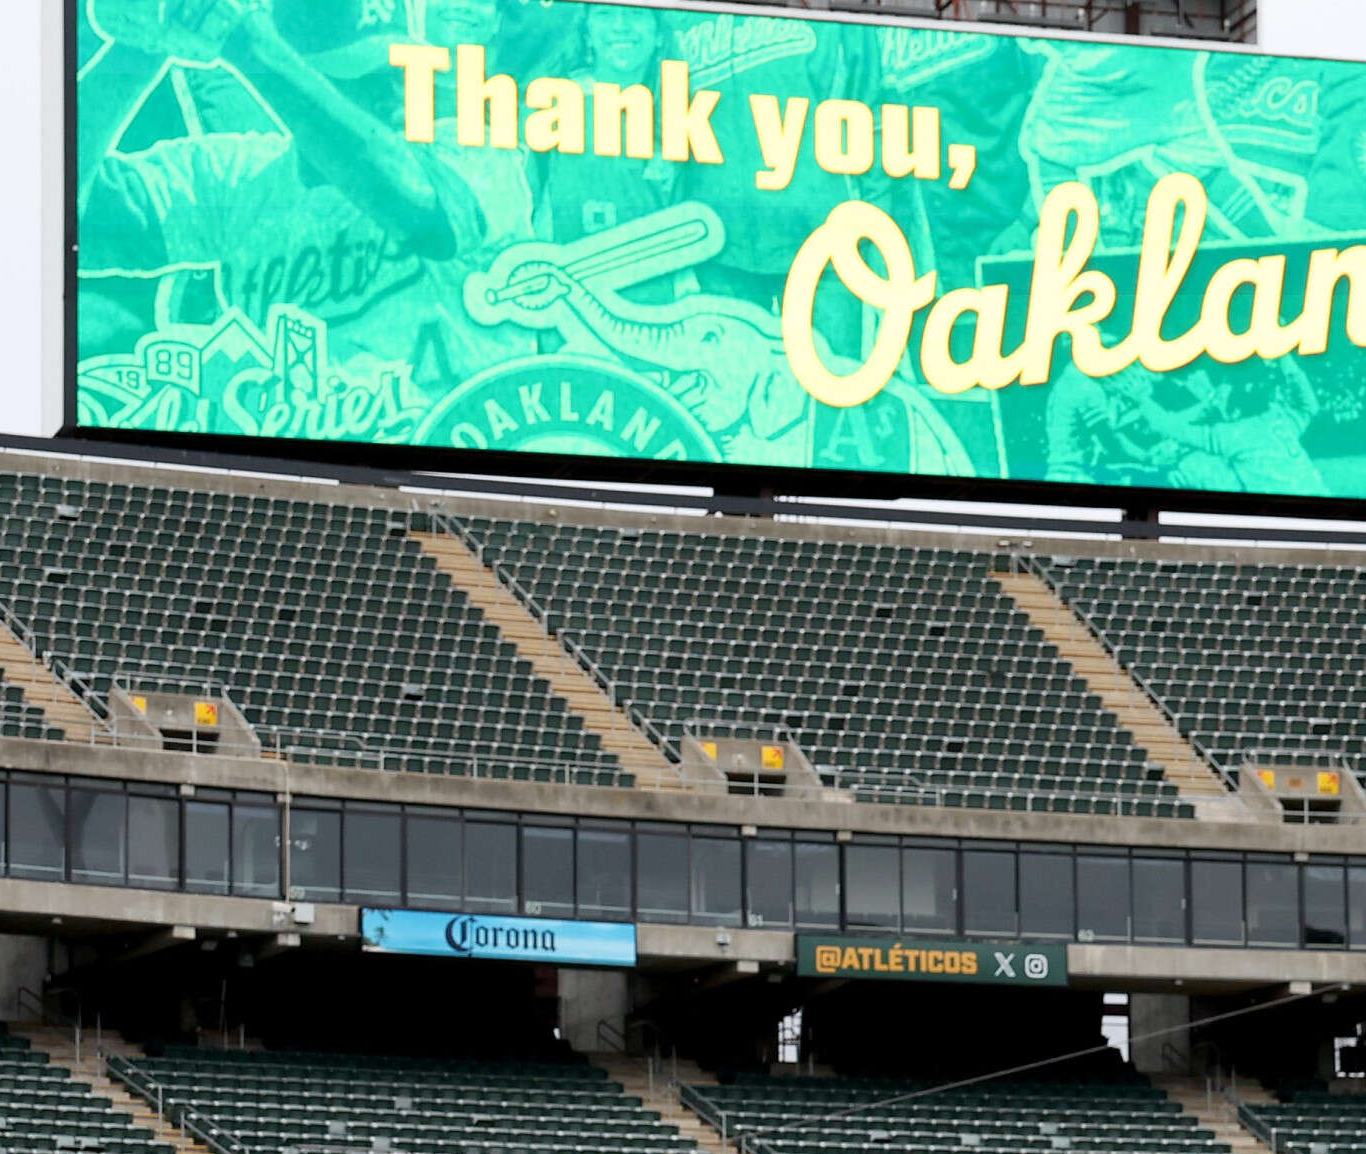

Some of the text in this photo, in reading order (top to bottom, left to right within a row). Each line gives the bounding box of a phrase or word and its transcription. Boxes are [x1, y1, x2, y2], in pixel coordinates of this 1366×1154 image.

[389, 43, 724, 165] Thank
[750, 93, 977, 190] you,
[155, 348, 193, 381] 89
[444, 912, 556, 957] Corona
[815, 942, 978, 975] @ATLÉTICOS
